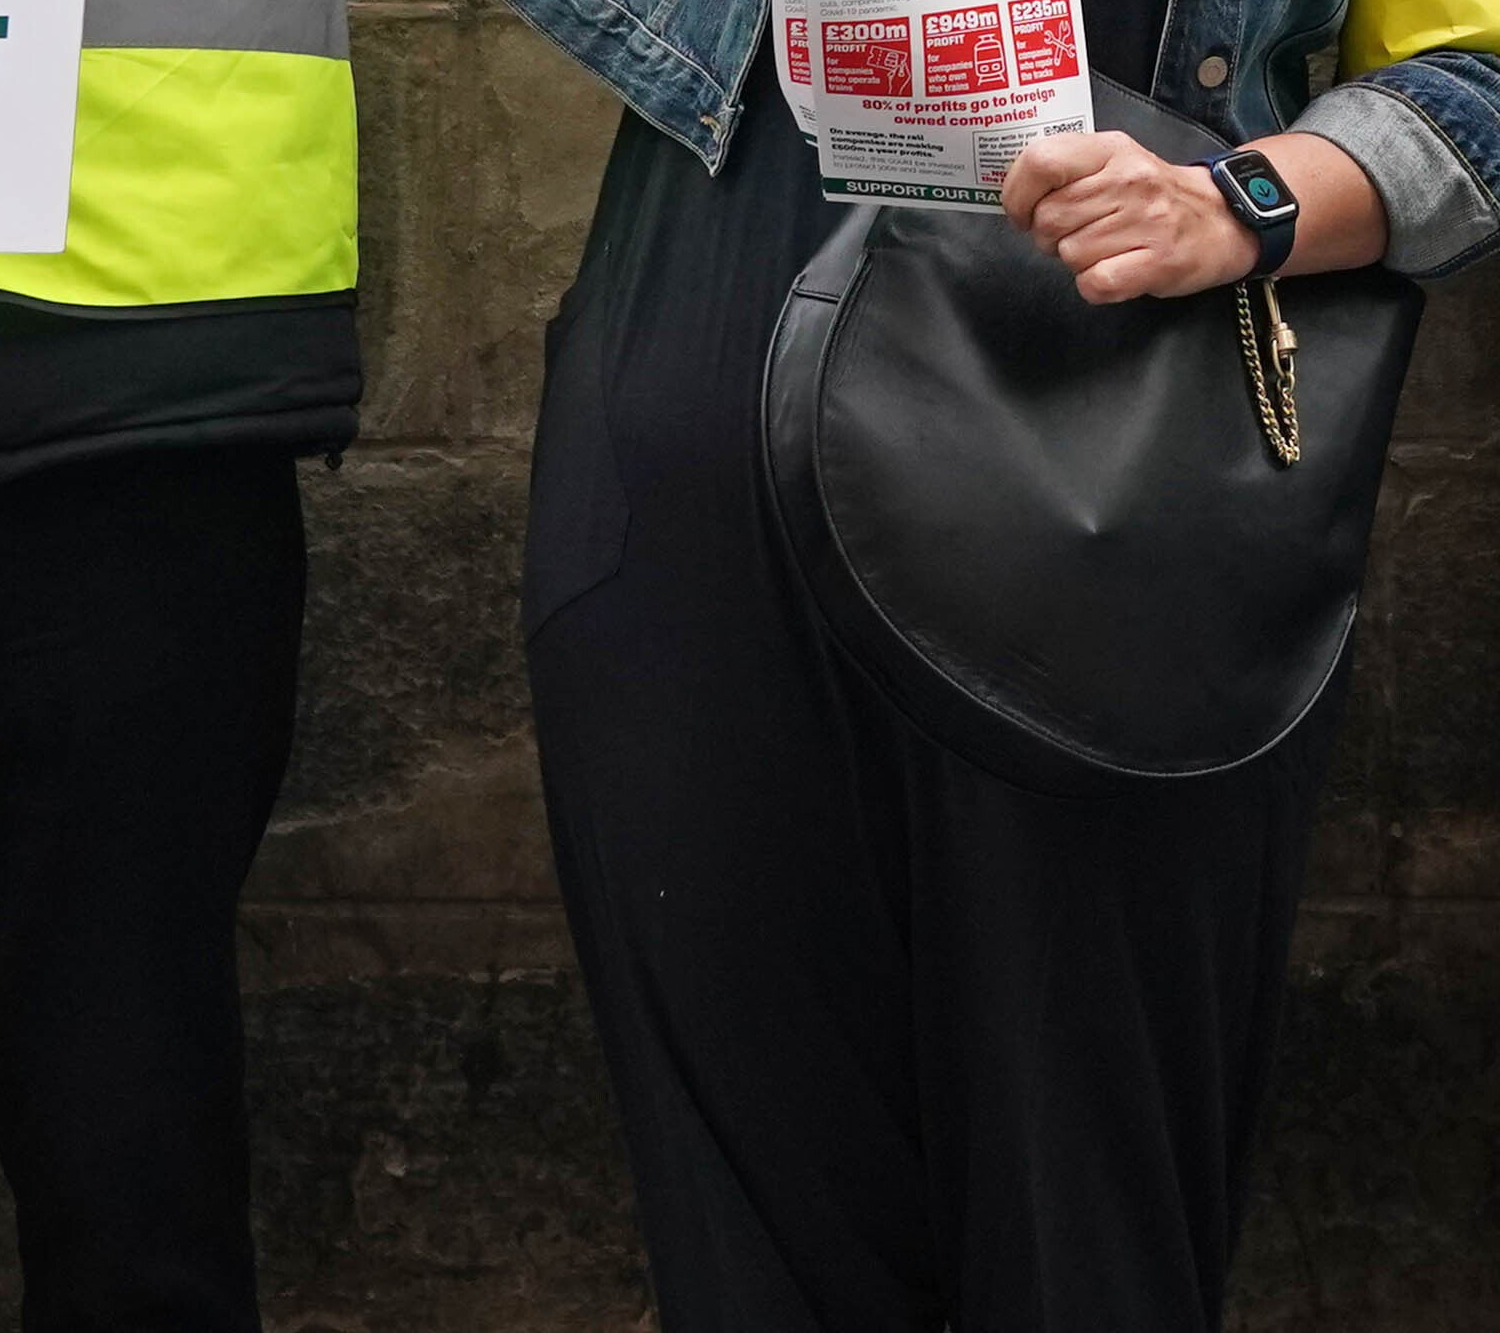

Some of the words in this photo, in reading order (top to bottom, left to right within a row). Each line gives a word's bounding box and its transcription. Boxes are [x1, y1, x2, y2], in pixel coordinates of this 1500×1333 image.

[826, 22, 908, 41] £300m
[926, 10, 998, 34] £949m
[1014, 21, 1044, 35] PROFIT
[826, 43, 867, 53] PROFIT
[926, 34, 965, 48] PROFIT
[862, 99, 892, 111] 80%
[896, 100, 910, 112] of
[914, 100, 967, 114] profits
[970, 99, 989, 113] go
[992, 96, 1007, 106] to
[1010, 88, 1056, 105] foreign
[894, 114, 946, 126] owned
[949, 106, 1038, 127] companies!
[846, 181, 930, 197] SUPPORT
[932, 188, 970, 201] OUR
